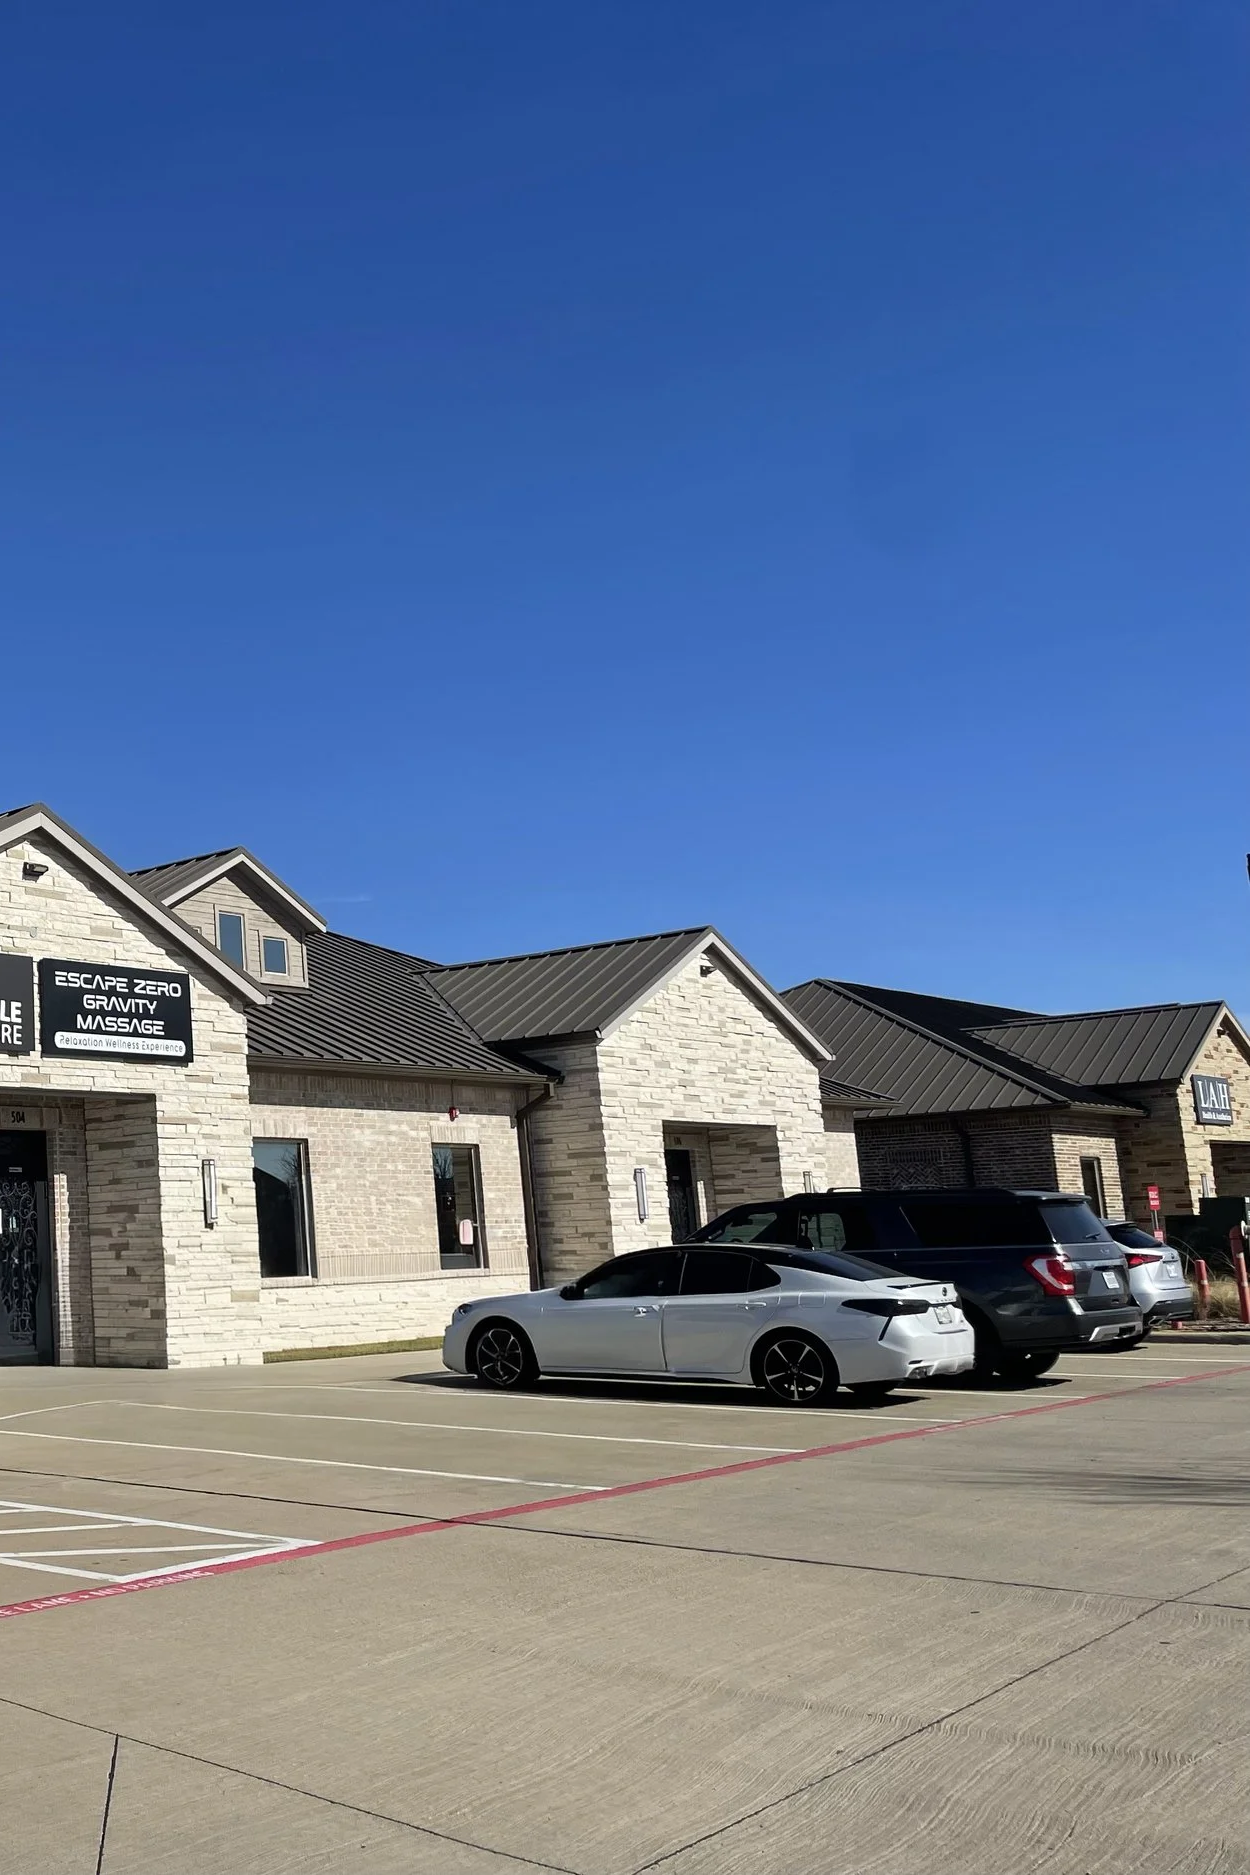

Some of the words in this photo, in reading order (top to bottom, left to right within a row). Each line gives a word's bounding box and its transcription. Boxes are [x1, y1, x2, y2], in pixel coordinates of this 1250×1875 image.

[54, 970, 129, 993] ESCAPE
[133, 979, 182, 998] ZERO
[83, 994, 157, 1015] GRAVITY
[76, 1013, 165, 1036] MASSAGE
[59, 1034, 104, 1047] Relaxation
[105, 1038, 139, 1050] Wellness
[141, 1040, 184, 1053] Experience
[11, 1110, 26, 1124] 504
